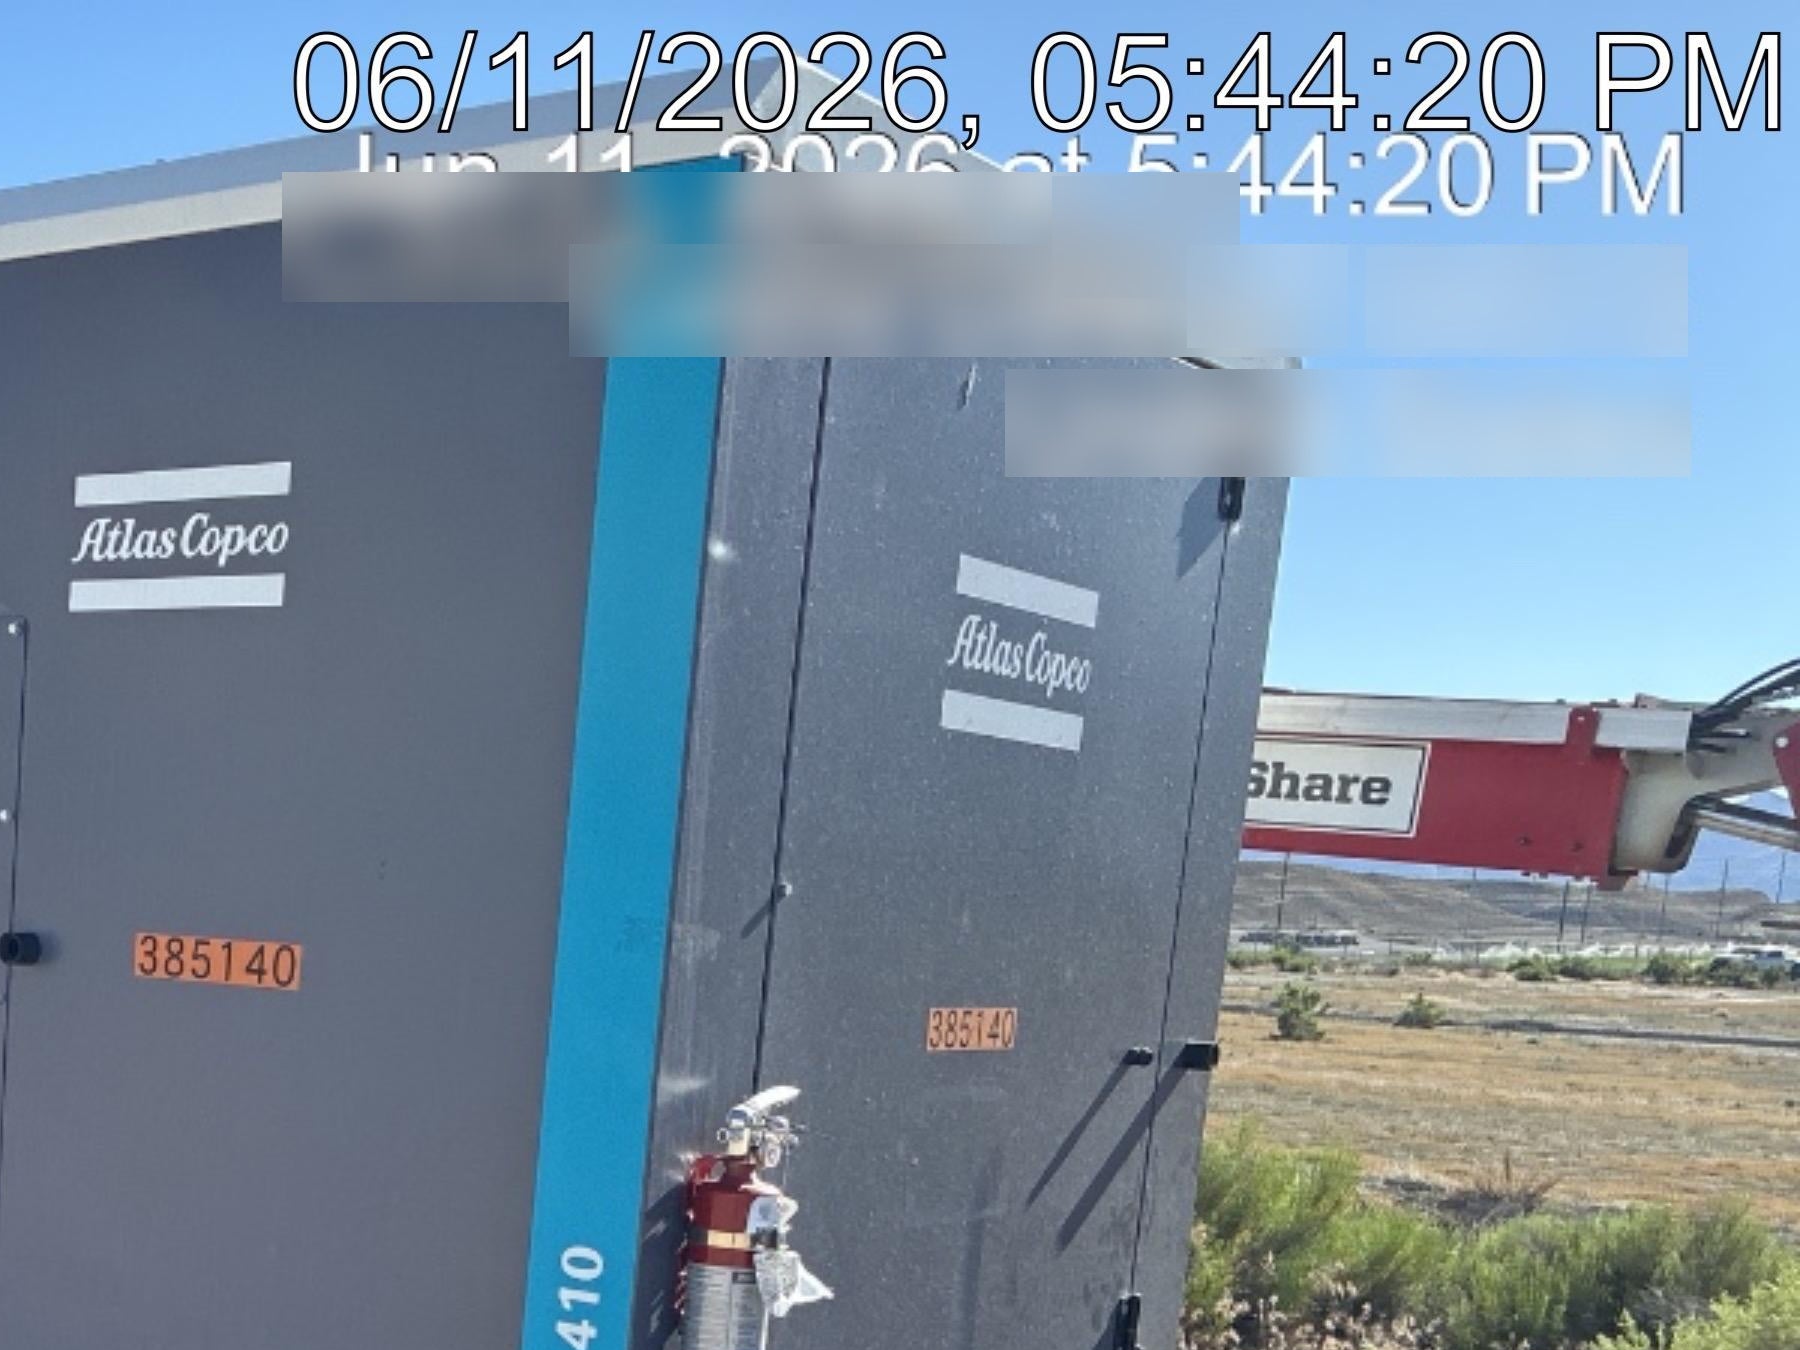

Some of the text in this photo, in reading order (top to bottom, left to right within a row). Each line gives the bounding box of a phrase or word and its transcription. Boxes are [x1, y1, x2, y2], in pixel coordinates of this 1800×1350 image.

[71, 512, 289, 567] Atlas Copco
[946, 613, 1092, 699] Atlas Copco
[138, 934, 297, 988] 385140
[929, 1009, 1015, 1049] 385140
